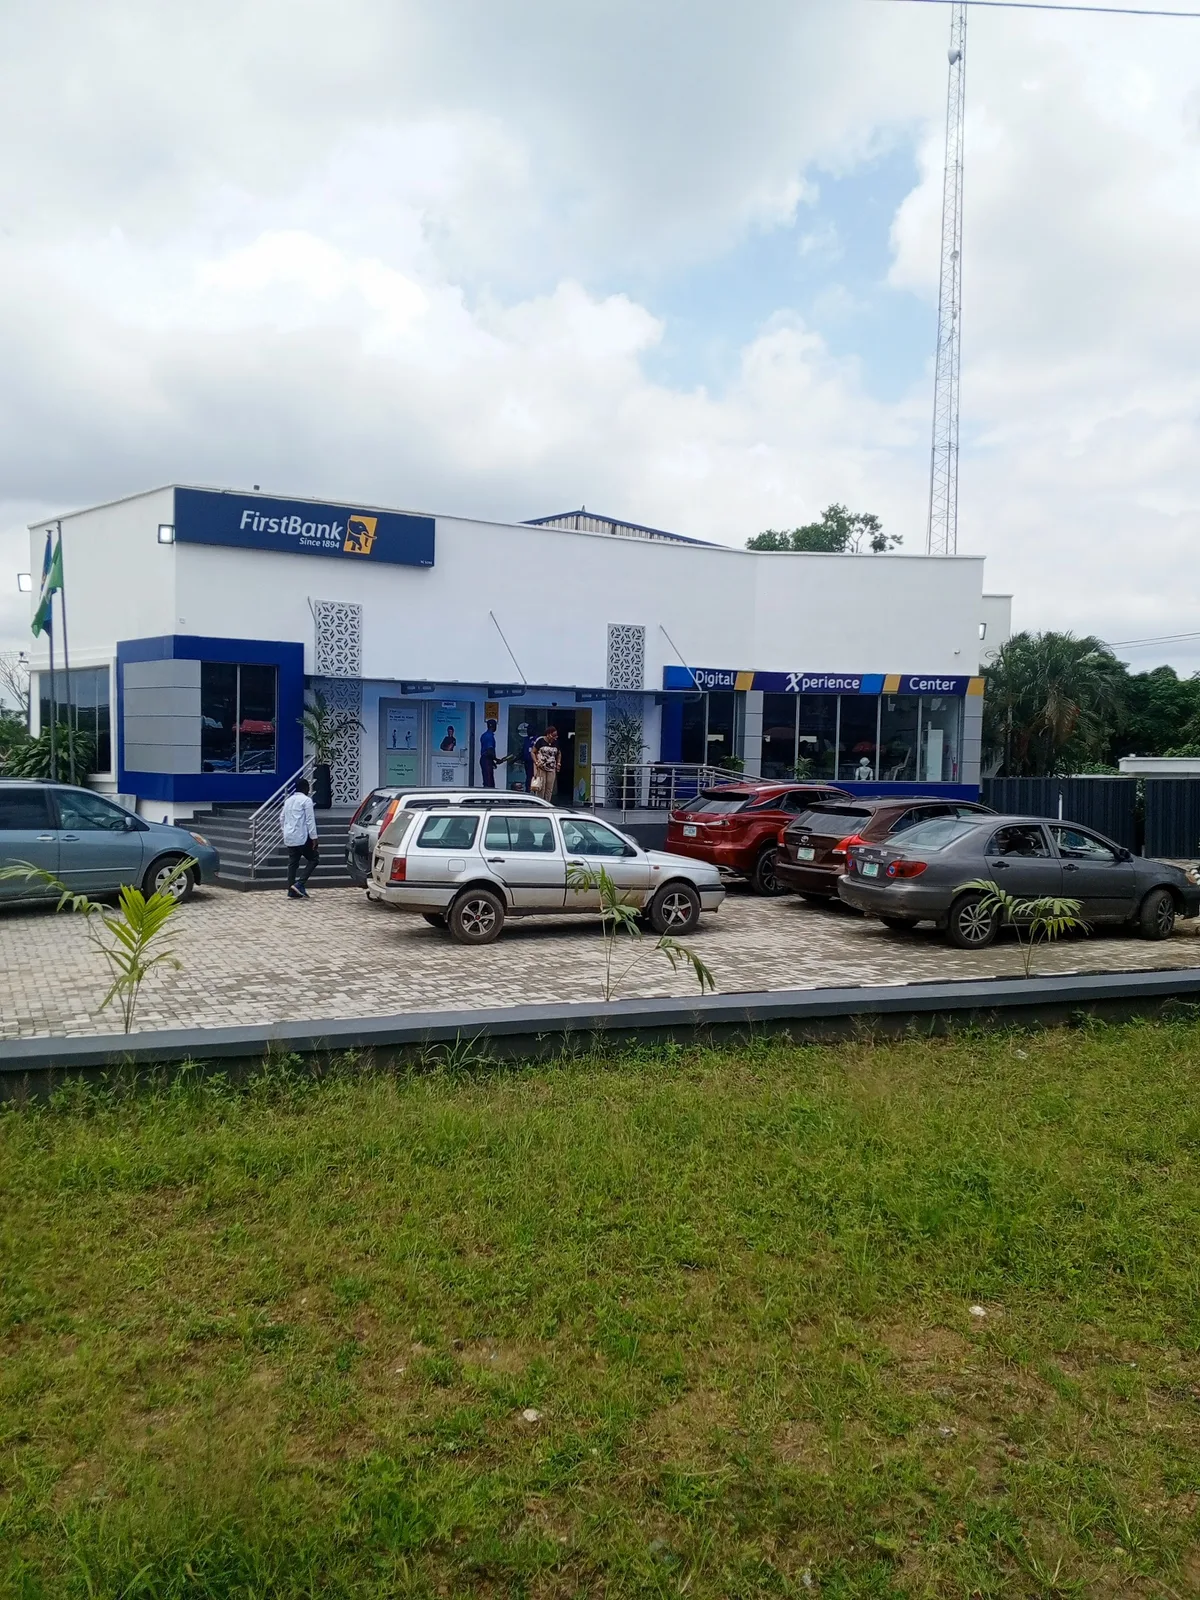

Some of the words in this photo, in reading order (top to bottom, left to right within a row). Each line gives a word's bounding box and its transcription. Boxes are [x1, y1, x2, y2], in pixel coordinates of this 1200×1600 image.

[240, 510, 343, 540] FirstBank
[299, 537, 321, 547] Since
[322, 539, 340, 549] 1894
[694, 670, 734, 688] Digital
[909, 677, 956, 692] Center
